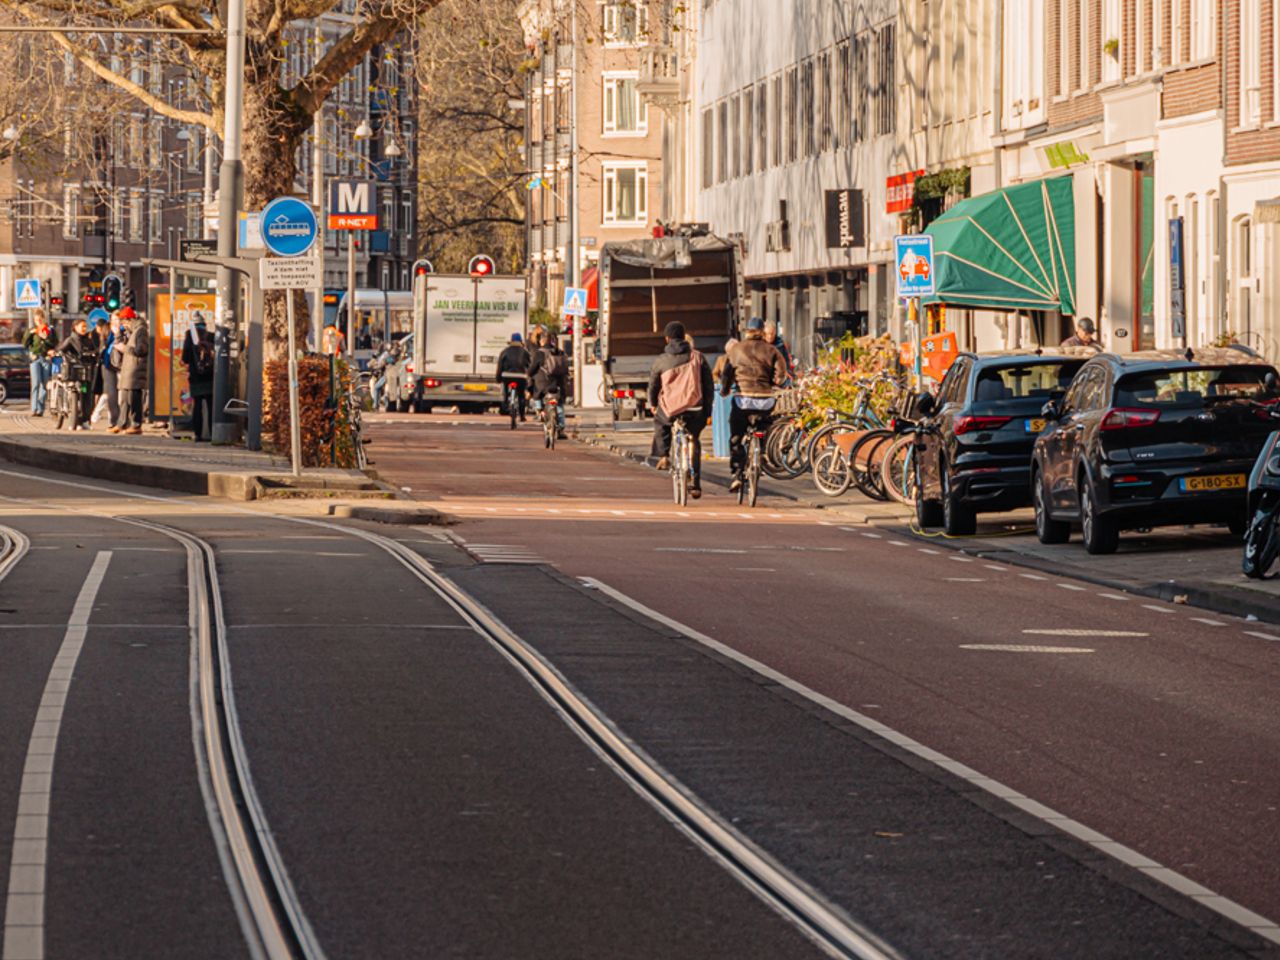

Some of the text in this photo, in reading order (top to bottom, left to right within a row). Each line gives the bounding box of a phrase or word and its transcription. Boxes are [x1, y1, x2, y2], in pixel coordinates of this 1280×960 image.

[338, 182, 369, 213] M
[839, 190, 854, 247] wework
[432, 300, 450, 309] JAN
[492, 301, 507, 311] VIS
[1189, 476, 1241, 489] G-180-SX
